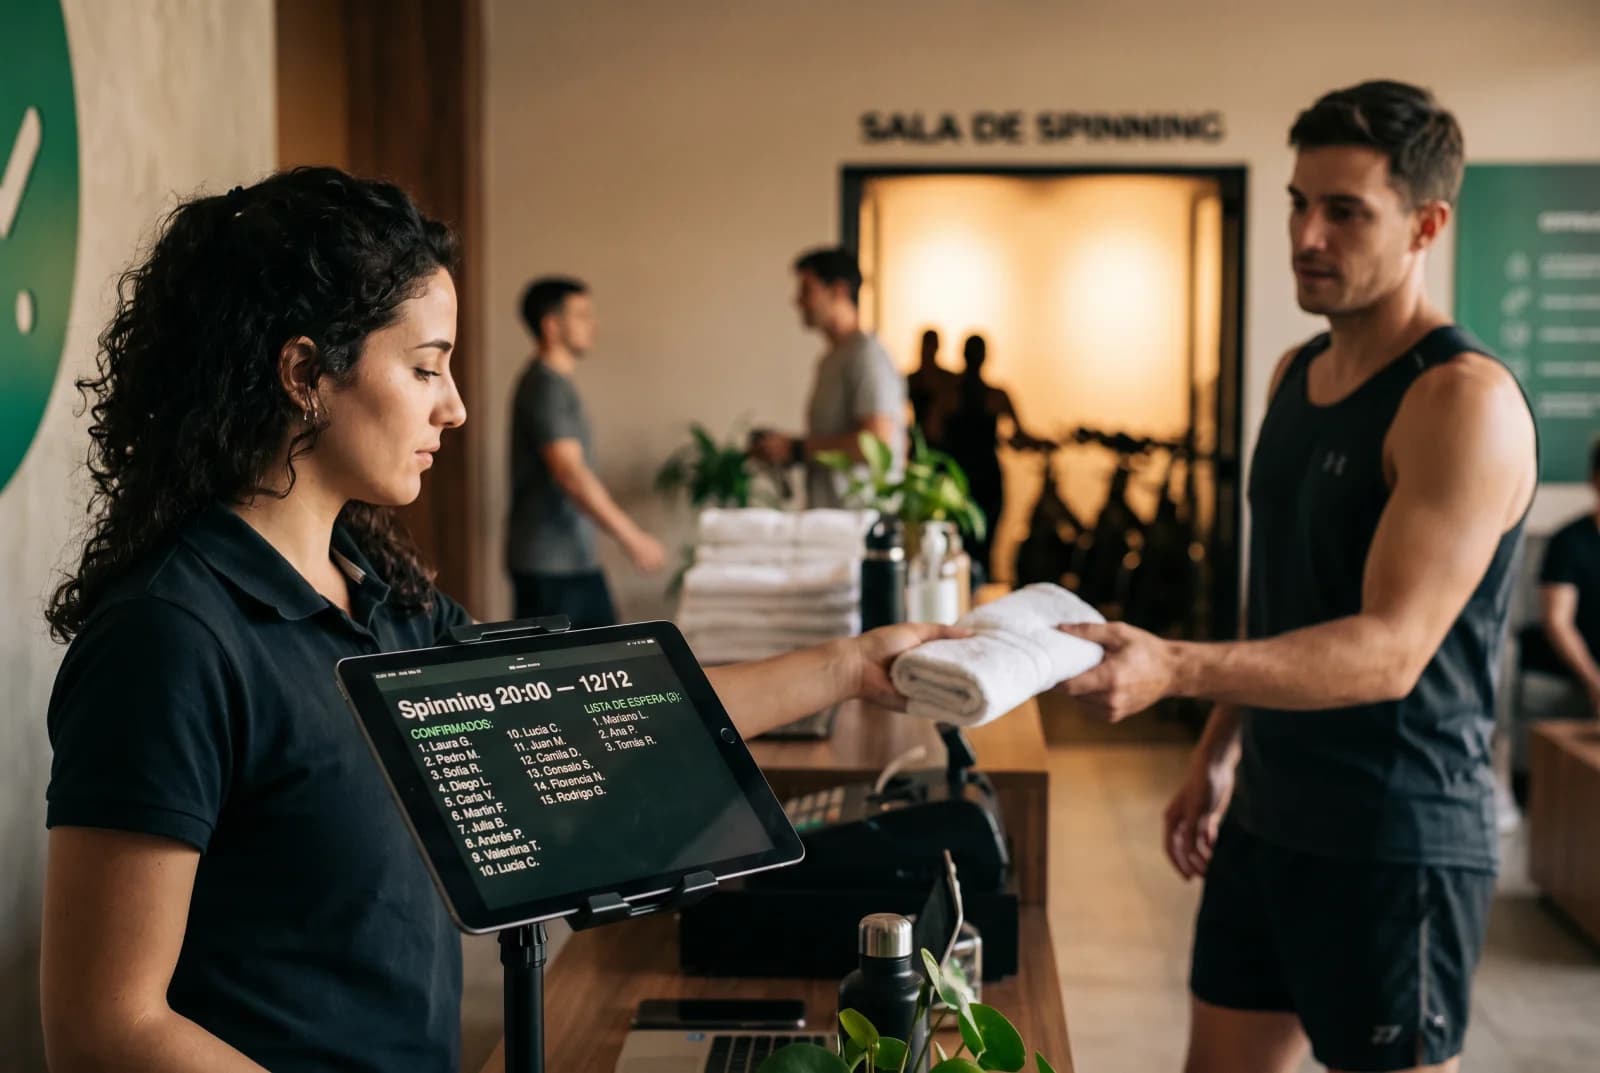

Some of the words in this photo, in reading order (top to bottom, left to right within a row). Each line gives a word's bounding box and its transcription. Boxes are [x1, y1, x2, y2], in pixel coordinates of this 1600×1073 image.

[860, 112, 961, 142] SALA
[971, 112, 1023, 142] DE
[1037, 112, 1225, 142] SPINNING
[398, 692, 496, 721] Spinning
[495, 681, 552, 705] 20:00
[579, 670, 633, 692] 12/12
[584, 702, 613, 714] LISTA
[612, 699, 628, 710] DE
[627, 693, 666, 708] ESPERA
[666, 691, 682, 704] (3):
[592, 717, 602, 726] 1.
[602, 712, 638, 725] Mariano
[638, 710, 648, 720] L.
[410, 719, 494, 740] CONFIRMADOS:
[506, 729, 522, 740] 10.
[549, 723, 562, 732] C.
[598, 730, 608, 739] 2.
[610, 726, 628, 738] Ana
[628, 724, 638, 734] P.
[418, 744, 429, 752] 1.
[429, 740, 459, 752] Laura
[460, 736, 472, 746] G.
[514, 742, 529, 752] 11.
[530, 738, 554, 750] Juan
[552, 736, 566, 746] M.
[604, 742, 616, 752] 3.
[644, 736, 657, 745] R.
[424, 756, 436, 766] 2.
[436, 753, 466, 764] Pedro
[466, 749, 480, 759] M.
[520, 754, 536, 766] 12.
[536, 750, 570, 763] Camila
[568, 747, 582, 758] D.
[430, 770, 442, 780] 3.
[469, 763, 483, 773] R.
[526, 768, 544, 779] 13.
[582, 760, 594, 770] S.
[438, 784, 450, 793] 4.
[450, 780, 480, 792] Diego
[480, 776, 492, 786] L.
[534, 781, 550, 792] 14.
[550, 774, 594, 789] Florencia
[592, 771, 606, 782] N.
[444, 797, 456, 807] 5.
[456, 792, 484, 805] Carla
[484, 790, 495, 800] V.
[540, 794, 557, 806] 15.
[556, 788, 594, 802] Rodrigo
[594, 785, 606, 796] G.
[452, 810, 463, 821] 6.
[496, 802, 508, 813] F.
[458, 824, 470, 834] 7.
[472, 820, 496, 833] Julia
[494, 817, 508, 828] B.
[464, 838, 477, 848] 8.
[513, 828, 525, 840] P.
[472, 852, 484, 863] 9.
[484, 844, 530, 860] Valentina
[529, 840, 541, 851] T.
[480, 865, 498, 876] 10.
[526, 856, 540, 867] C.
